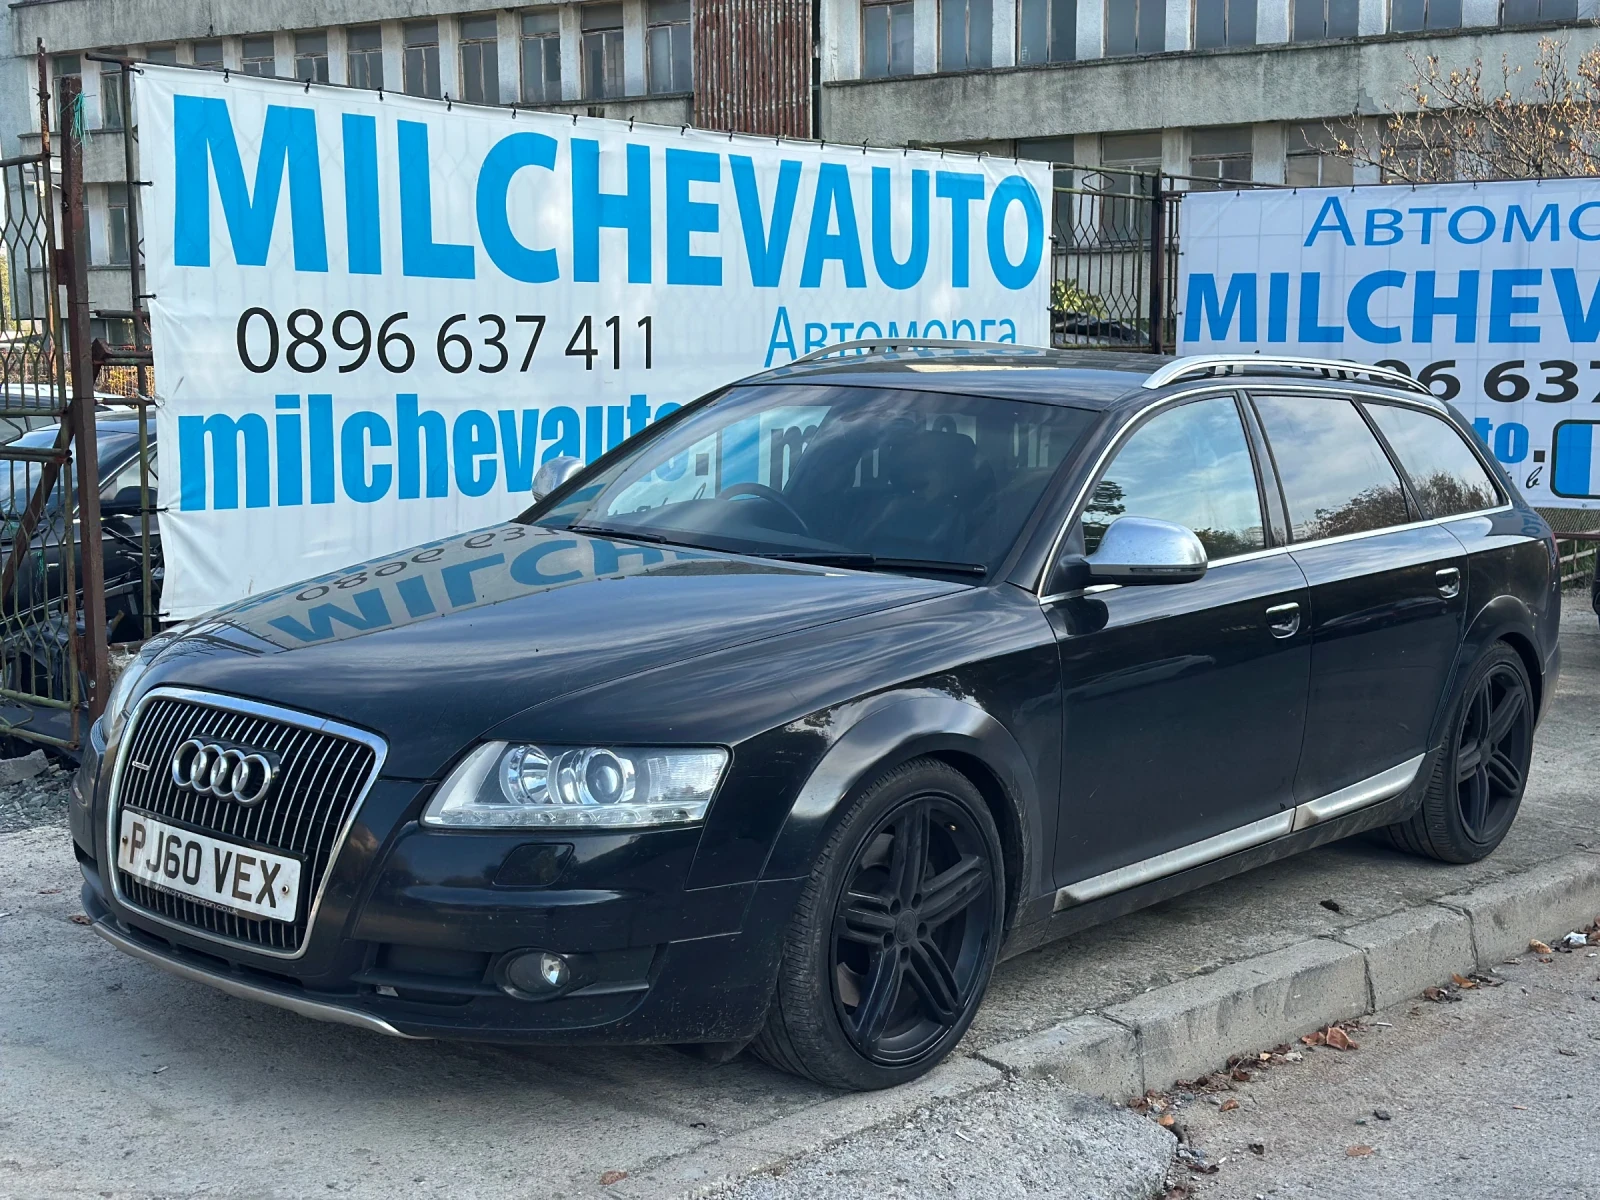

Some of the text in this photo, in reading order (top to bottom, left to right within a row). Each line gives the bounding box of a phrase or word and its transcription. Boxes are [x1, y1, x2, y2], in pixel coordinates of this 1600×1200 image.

[173, 94, 1045, 290] MILCHEVAUTO
[236, 307, 654, 375] 0896 637 411
[1183, 267, 1600, 344] MILCHEV
[1484, 359, 1600, 403] 63
[129, 821, 281, 908] PJ60 VEX
